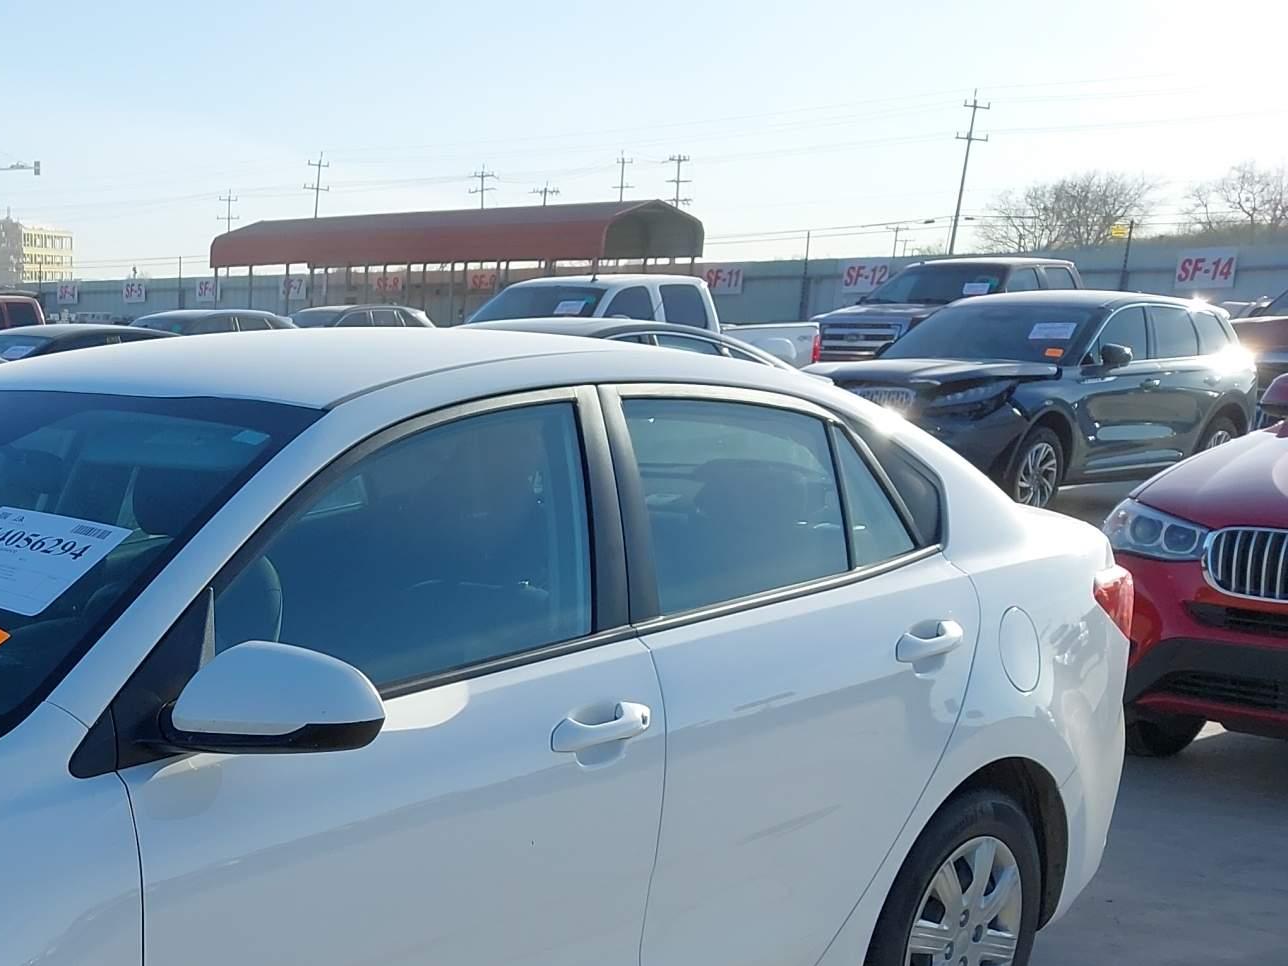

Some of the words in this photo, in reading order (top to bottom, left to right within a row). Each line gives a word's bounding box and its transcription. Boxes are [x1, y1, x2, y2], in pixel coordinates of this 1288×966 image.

[706, 268, 741, 288] SF-11
[844, 265, 888, 287] SF-12
[1177, 257, 1234, 282] SF-14
